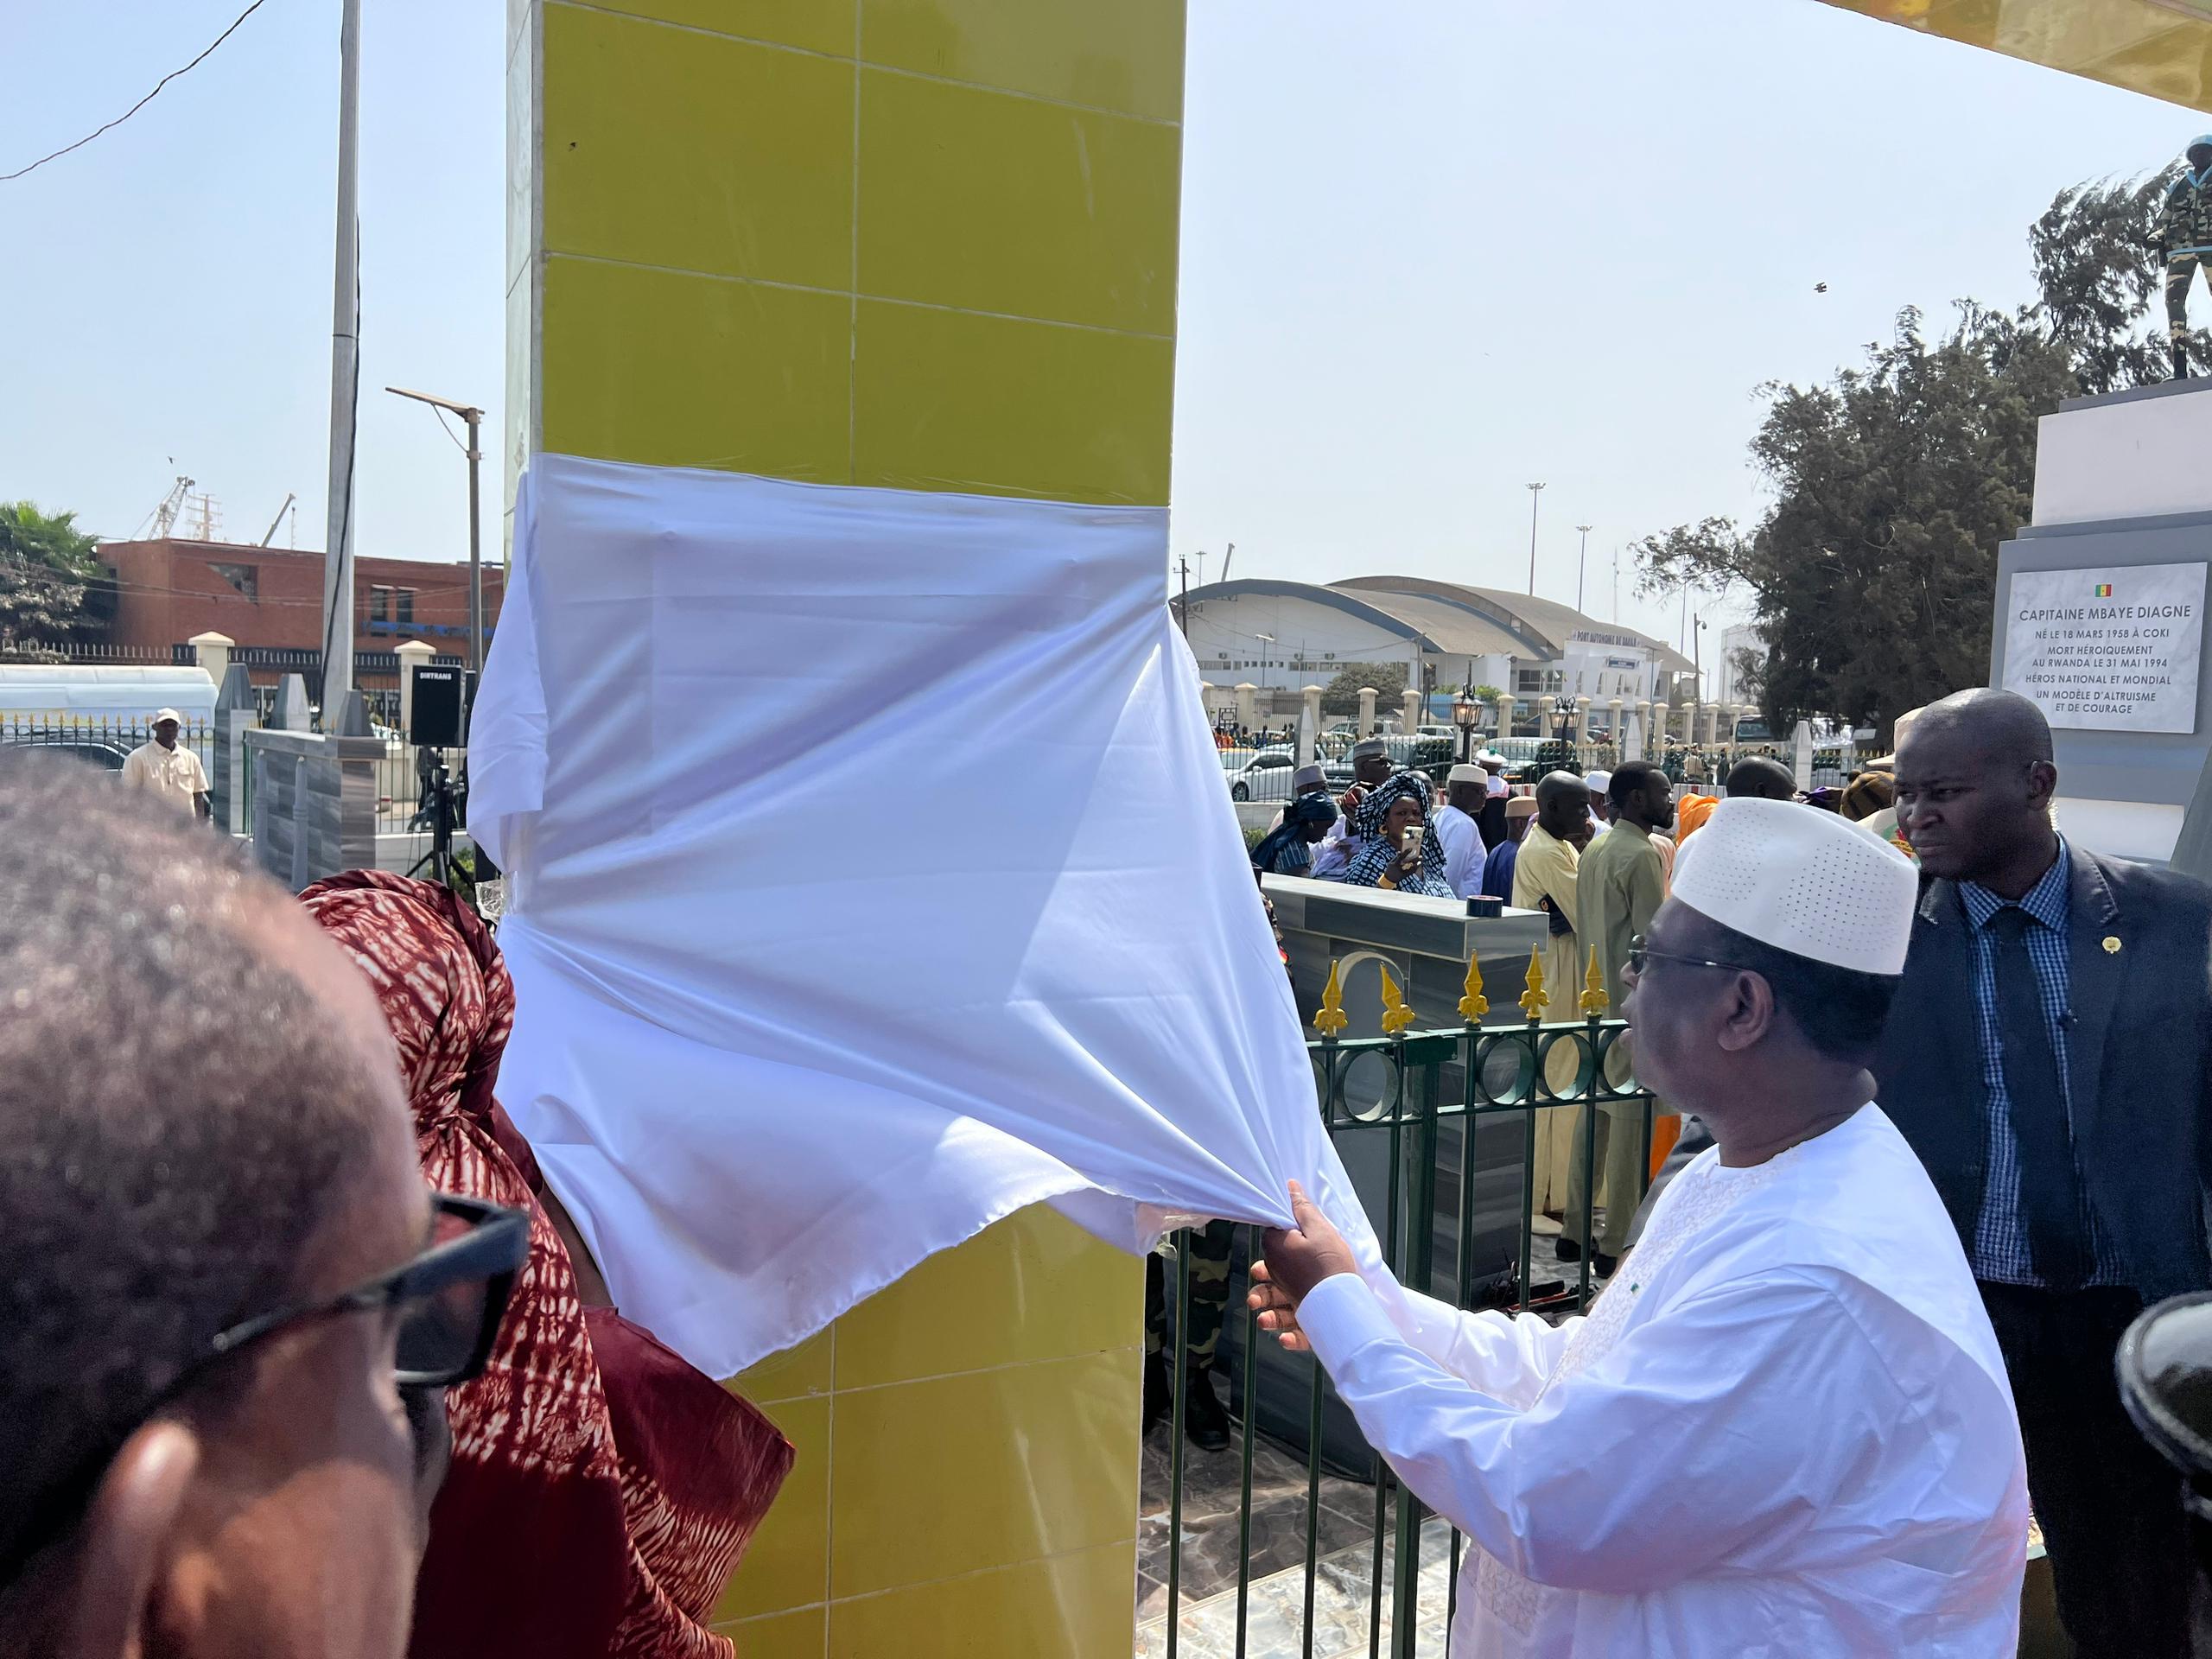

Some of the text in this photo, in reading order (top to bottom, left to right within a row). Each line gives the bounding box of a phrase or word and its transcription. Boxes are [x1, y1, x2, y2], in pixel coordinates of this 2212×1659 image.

[2019, 606, 2191, 620] CAPITAINE MBAYE DIAGNE
[1577, 631, 1589, 641] PORT
[2035, 629, 2047, 639] NÉ
[2076, 630, 2103, 639] MARS
[2133, 627, 2139, 638] À
[2143, 629, 2169, 638] COKI
[2032, 658, 2044, 667] AU
[2048, 658, 2090, 667] RWANDA
[2025, 673, 2055, 683] HÉROS
[2058, 675, 2107, 683] NATIONAL
[2123, 676, 2171, 684] MONDIAL
[2052, 689, 2090, 700] MODÈLE
[2094, 691, 2156, 701] D'ALTRUISME
[2082, 704, 2133, 714] COURAGE
